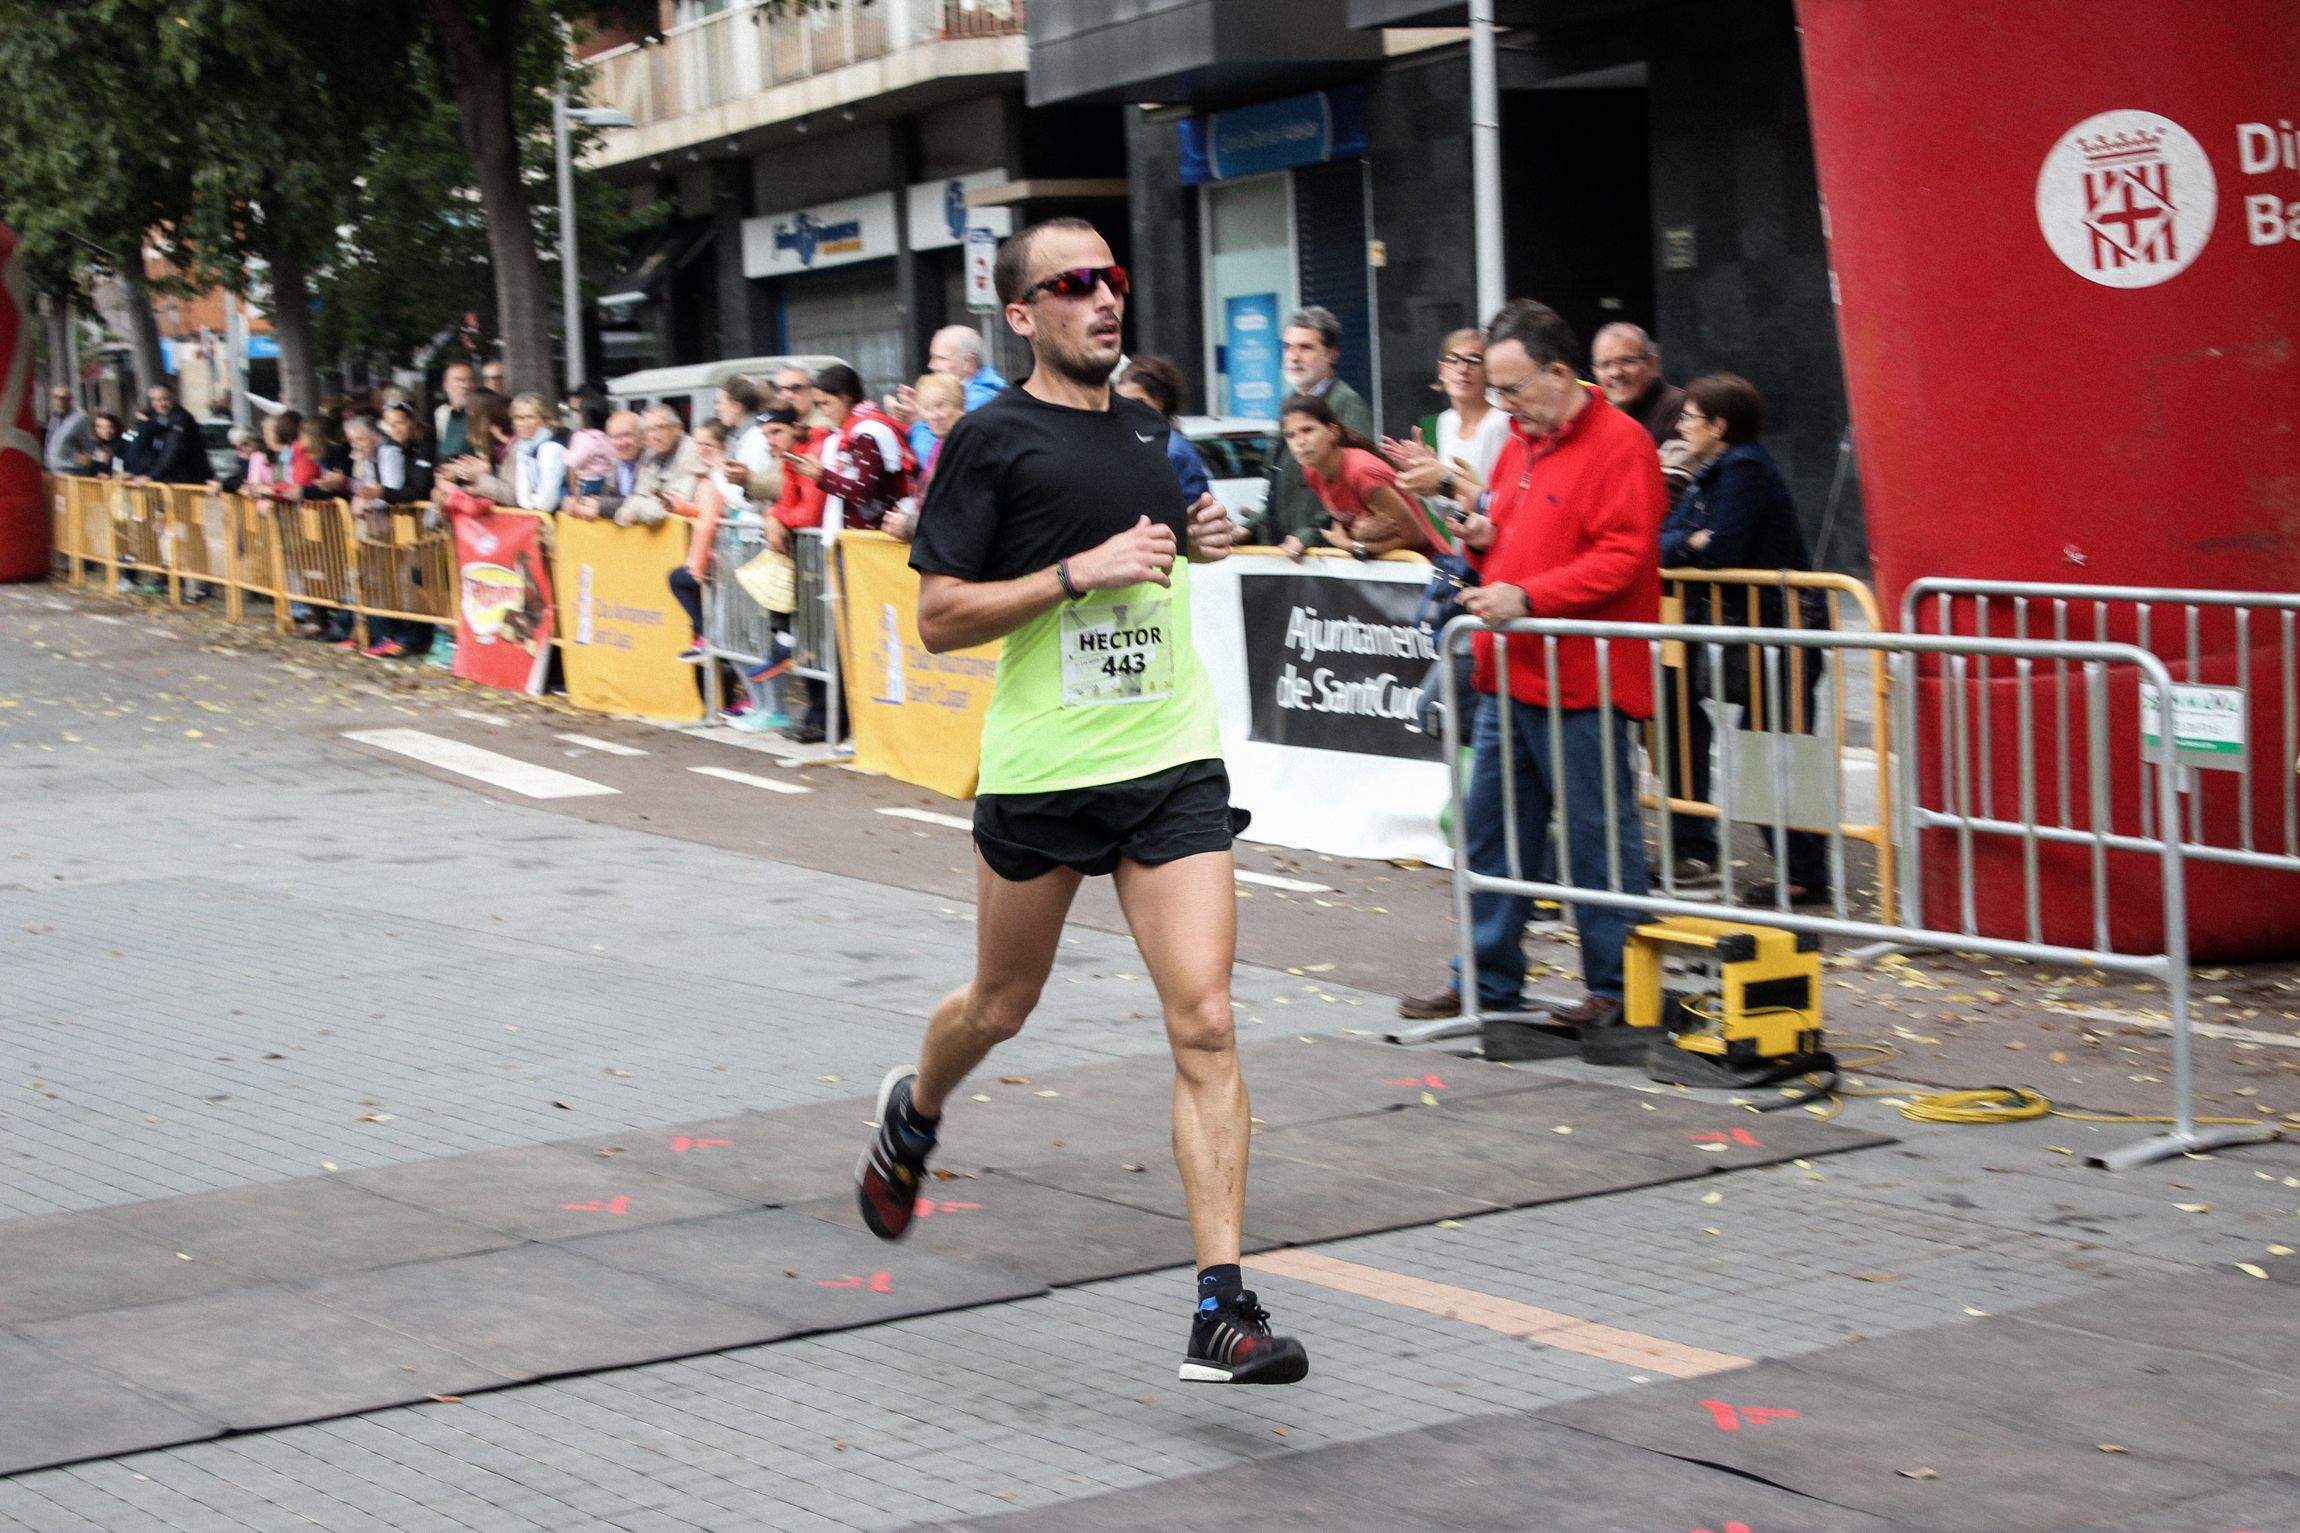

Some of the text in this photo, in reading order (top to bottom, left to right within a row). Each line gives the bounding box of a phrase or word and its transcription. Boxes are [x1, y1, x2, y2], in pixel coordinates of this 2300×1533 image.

[2236, 118, 2300, 175] Di
[1079, 626, 1163, 651] HECTOR
[1285, 605, 1441, 662] Ajuntament
[1101, 653, 1146, 677] 443
[1276, 662, 1425, 734] de Sant Cug
